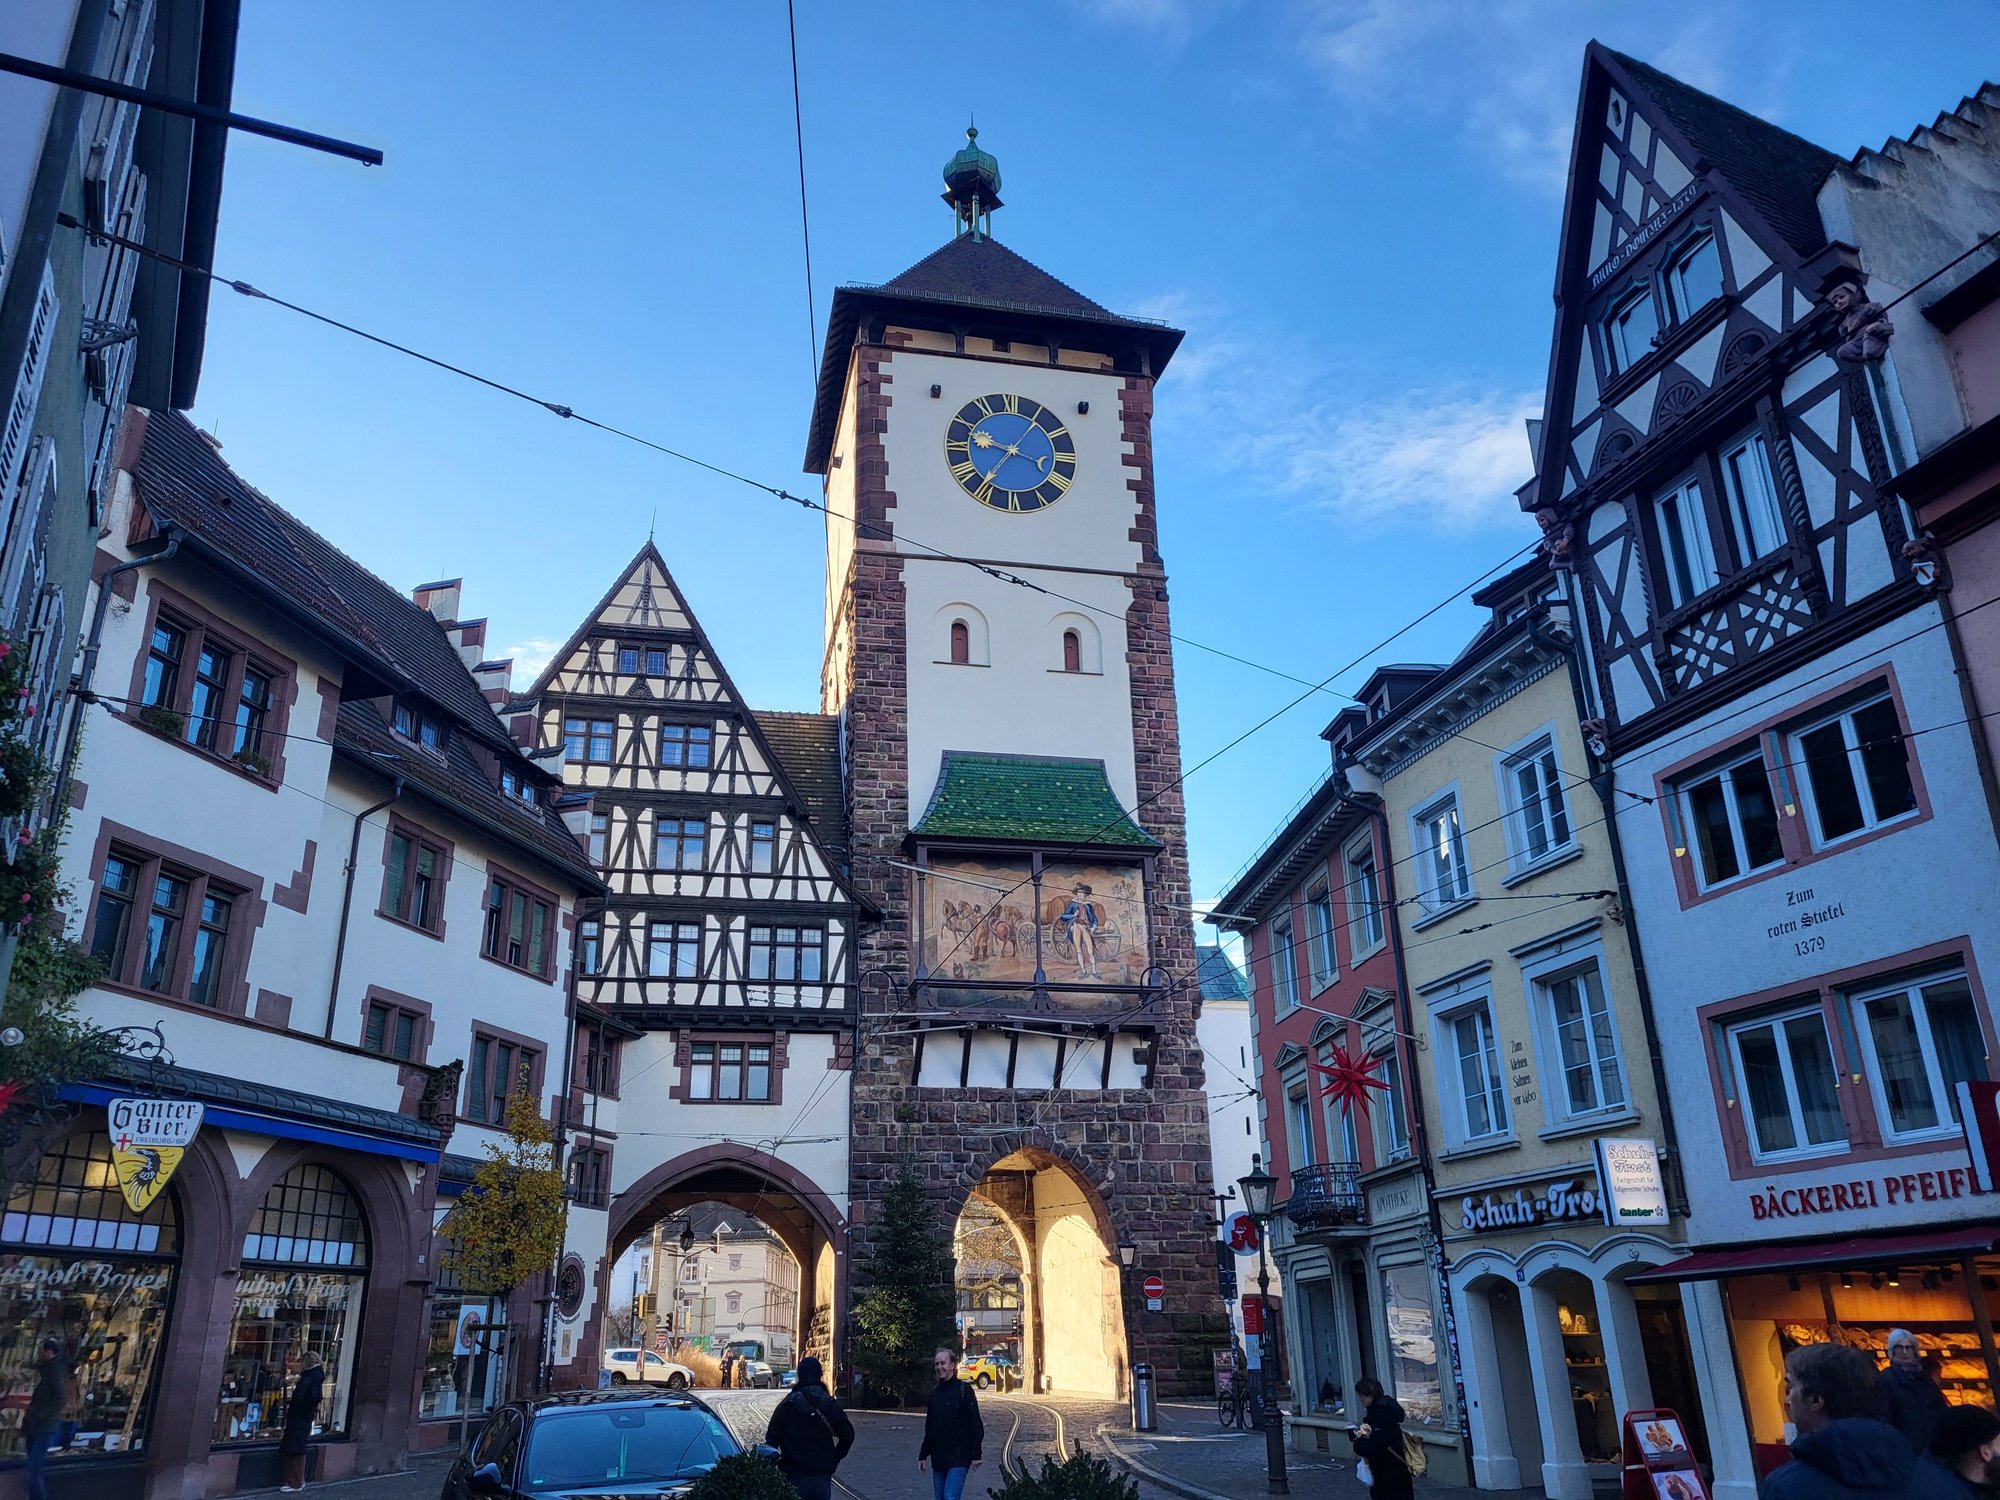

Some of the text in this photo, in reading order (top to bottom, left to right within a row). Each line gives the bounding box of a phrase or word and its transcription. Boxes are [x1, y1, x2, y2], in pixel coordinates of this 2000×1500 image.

[1002, 394, 1018, 413] XII
[1055, 452, 1076, 464] III
[1786, 888, 1815, 907] Zum
[1768, 902, 1845, 938] roten Stiefel
[1794, 936, 1826, 956] 1379
[1608, 1145, 1655, 1160] Schuh-
[1613, 1160, 1652, 1173] Trost
[1749, 1180, 1879, 1220] BÄCKEREI
[1619, 1208, 1655, 1217] Ganter
